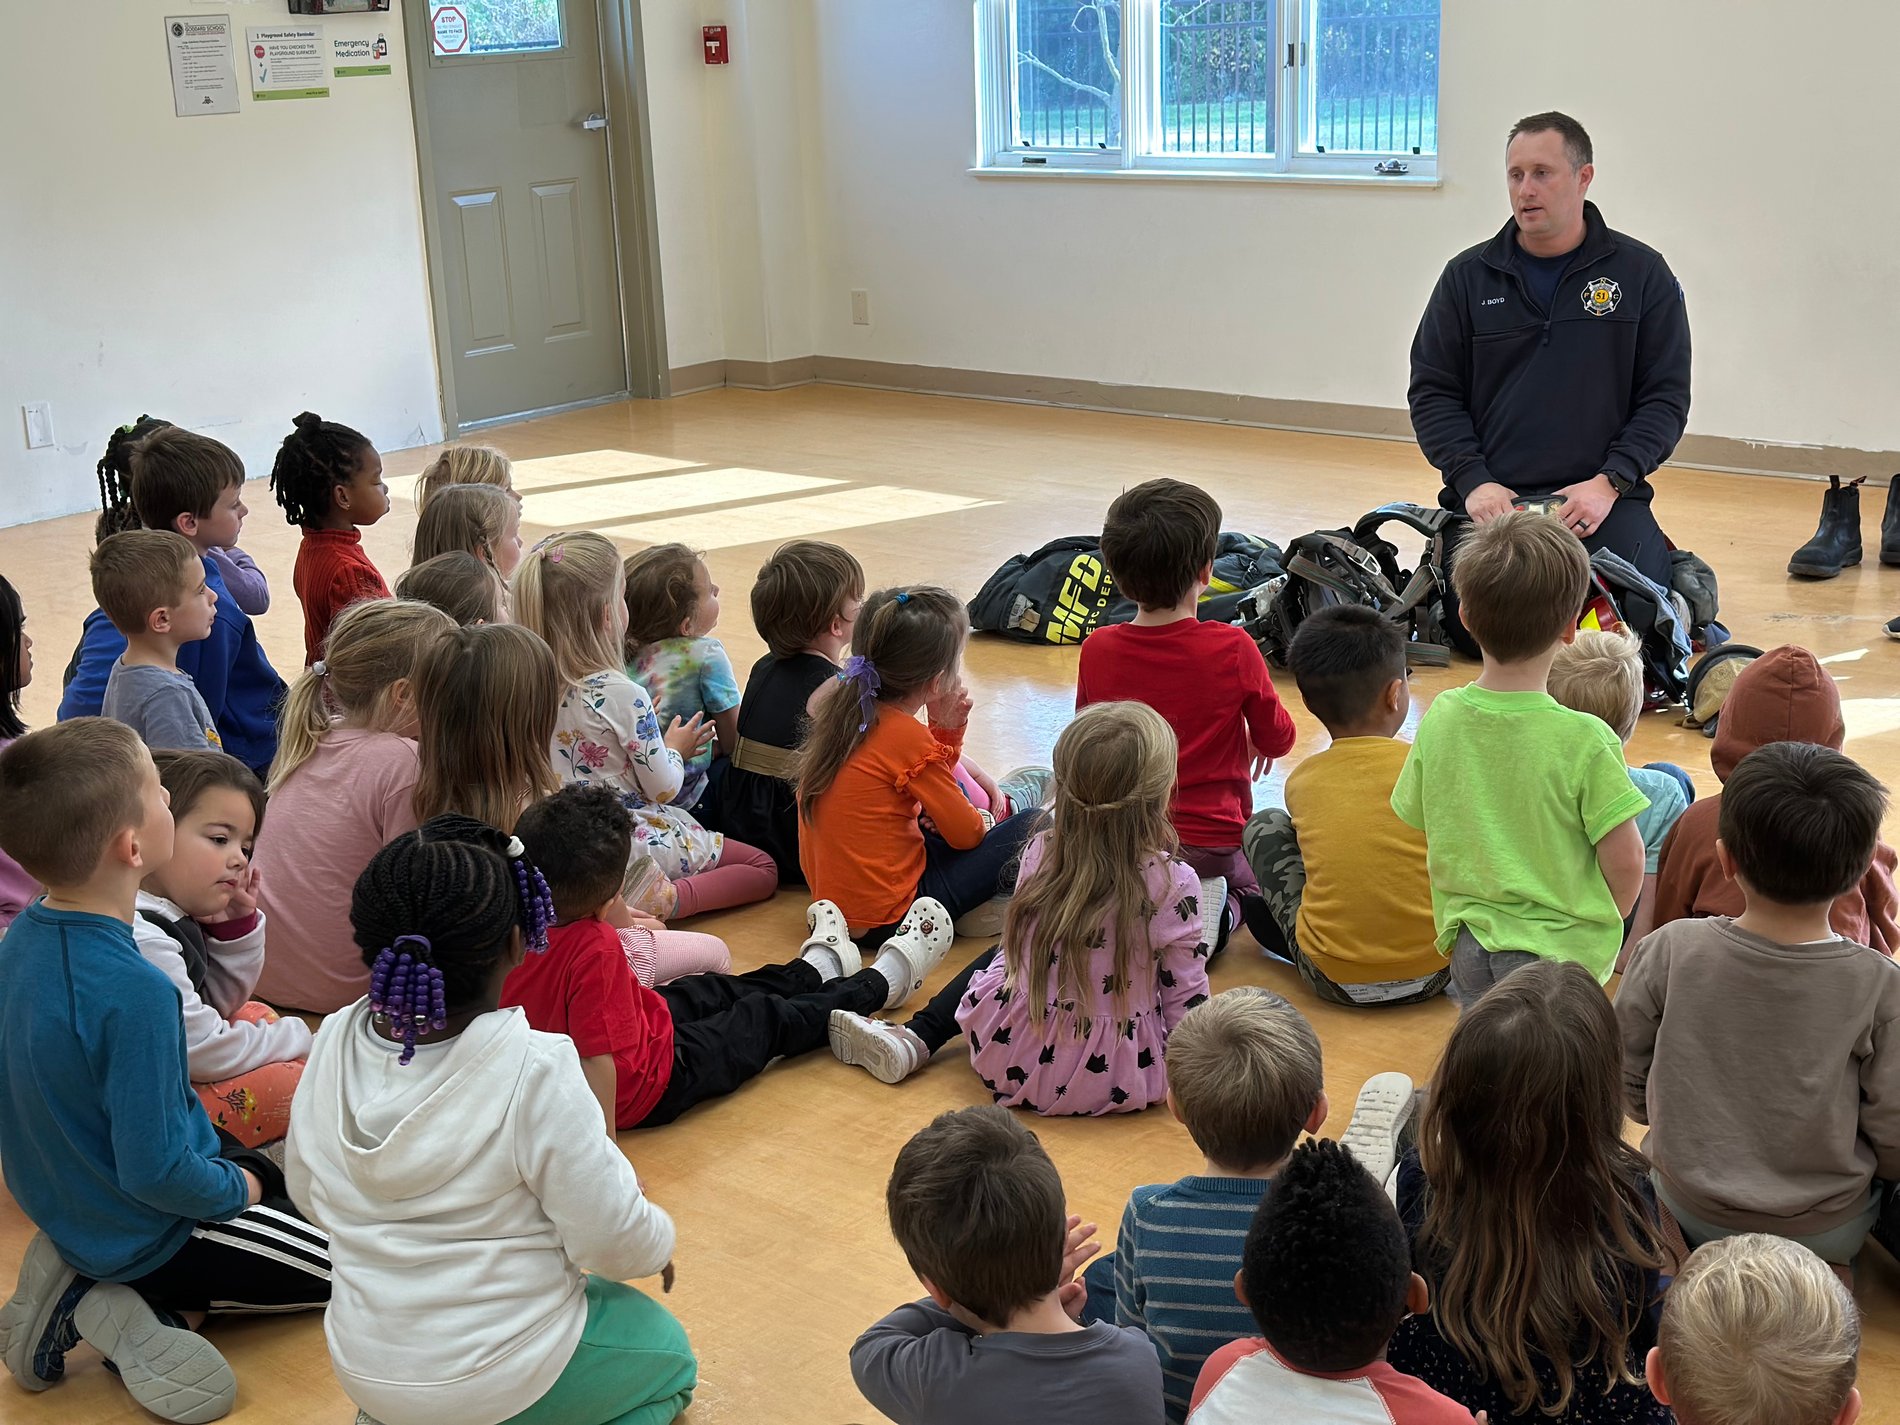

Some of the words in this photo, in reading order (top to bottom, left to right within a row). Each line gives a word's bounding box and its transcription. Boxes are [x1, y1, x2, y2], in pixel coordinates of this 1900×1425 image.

[334, 40, 369, 48] Emergency
[335, 49, 370, 57] Medication
[1596, 292, 1605, 300] 51
[1487, 297, 1505, 305] BOYD
[1046, 554, 1102, 644] MFD
